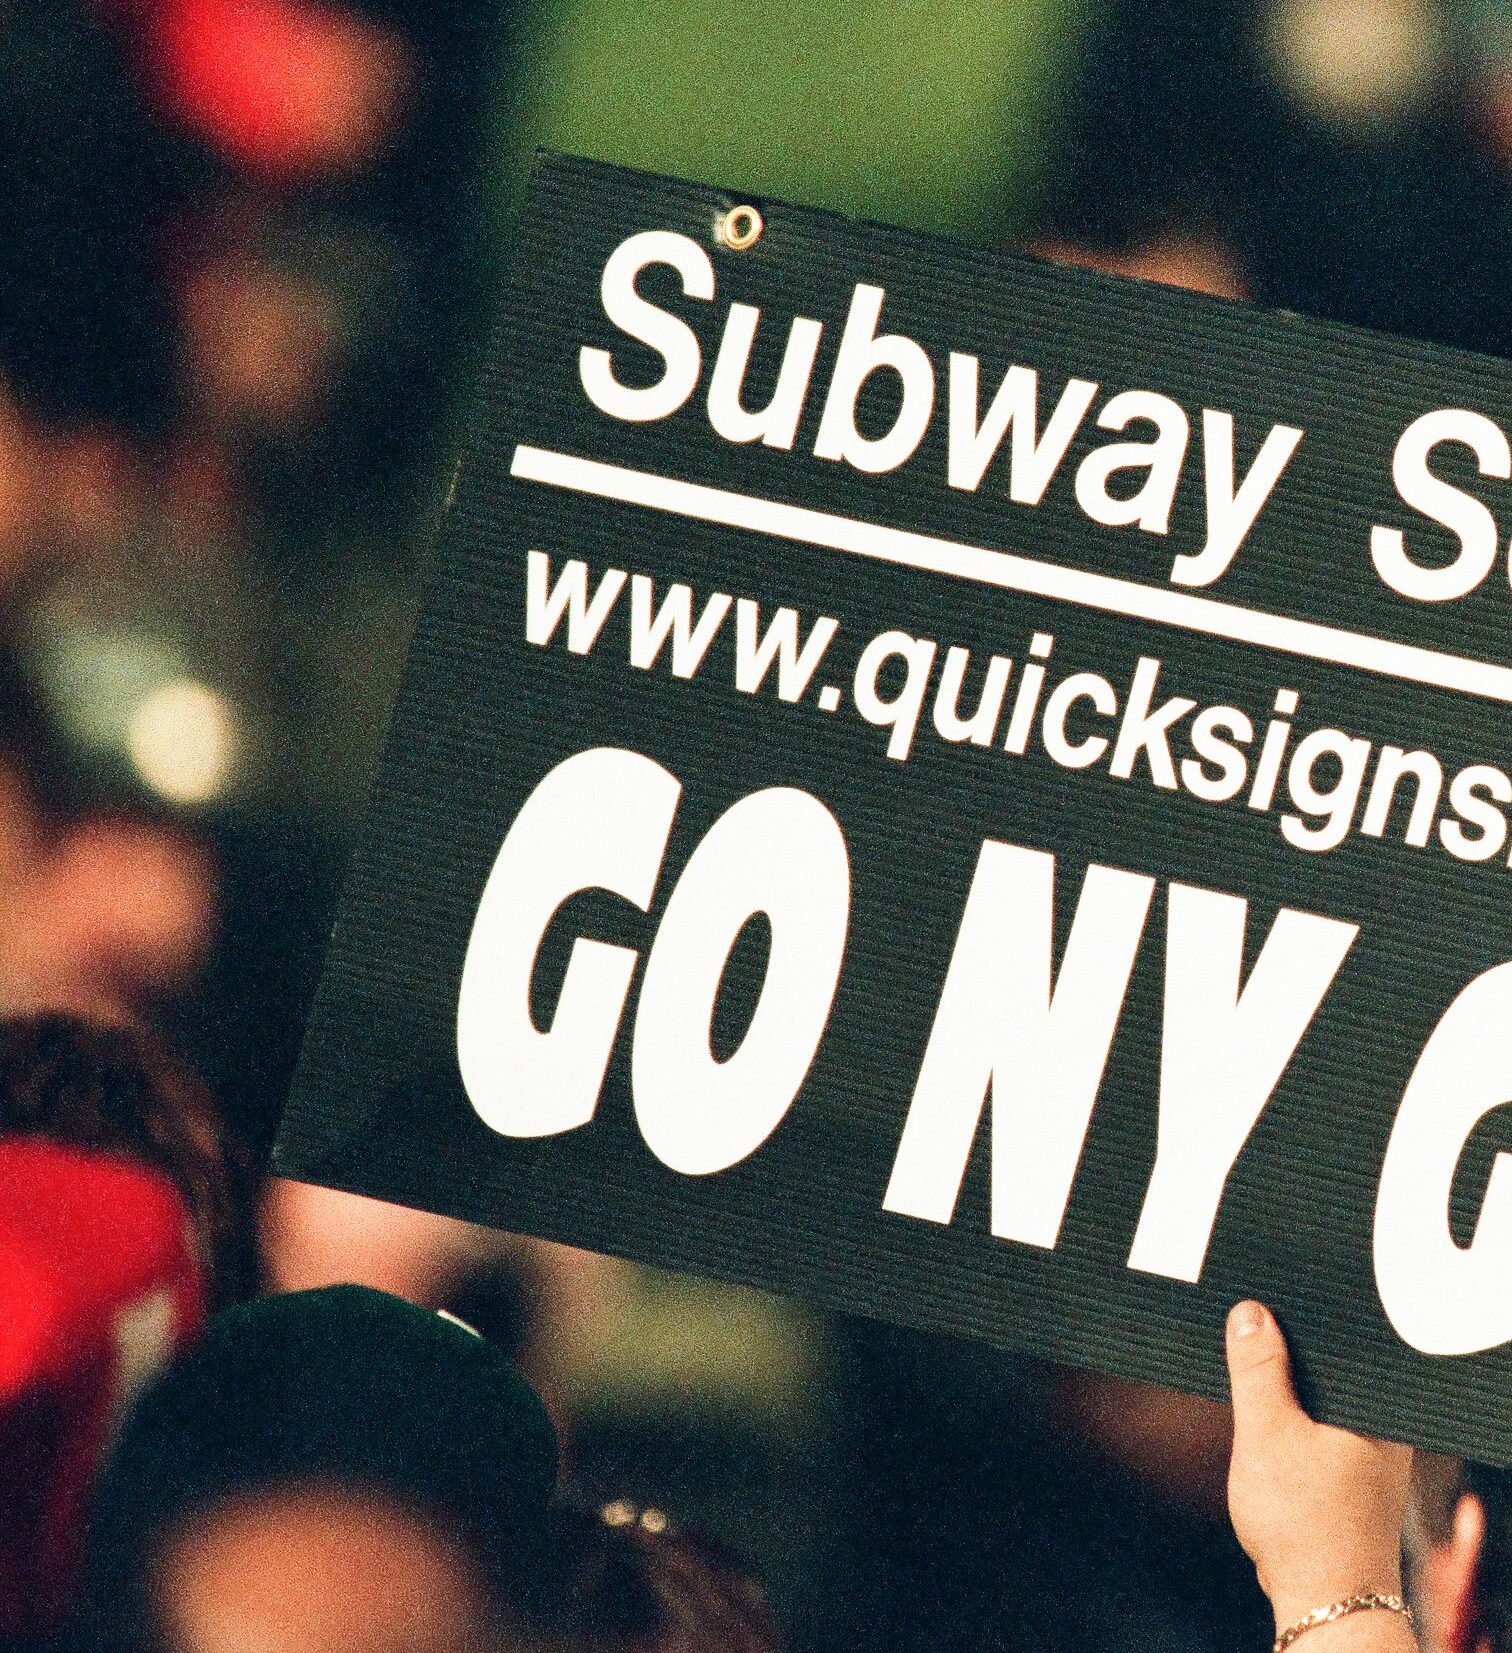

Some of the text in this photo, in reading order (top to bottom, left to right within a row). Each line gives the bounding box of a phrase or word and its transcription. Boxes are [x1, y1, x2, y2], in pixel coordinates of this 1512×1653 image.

[579, 230, 1304, 588] Subway
[456, 746, 851, 1176] GO
[881, 838, 1360, 1284] NY
